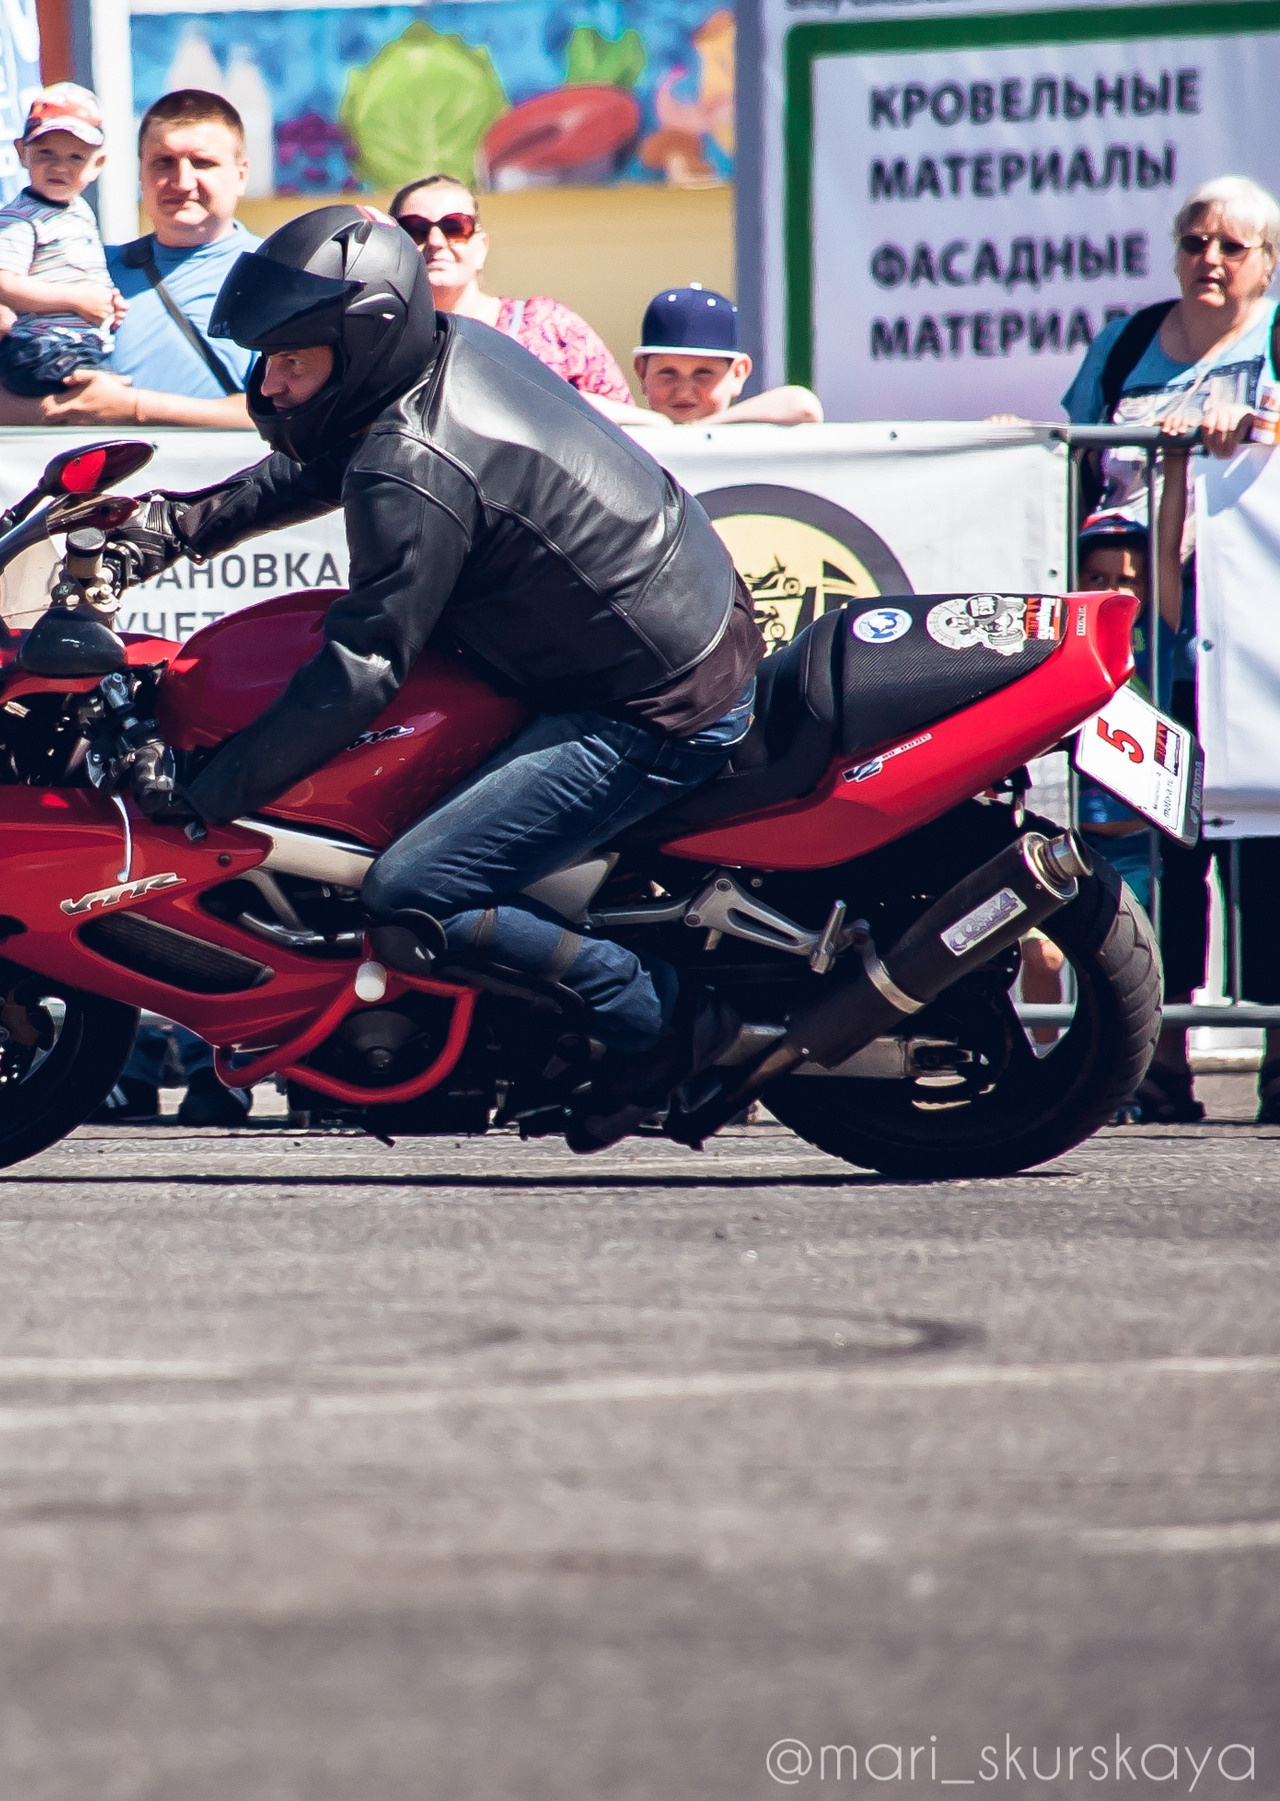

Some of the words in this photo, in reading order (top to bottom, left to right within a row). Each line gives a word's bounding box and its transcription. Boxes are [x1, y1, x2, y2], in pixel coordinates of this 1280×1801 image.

[869, 68, 1201, 128] КРОВЕЛЬНЫЕ
[869, 142, 1176, 200] МАТЕРИАЛЫ
[870, 232, 1150, 292] ФАСАДНЫЕ
[870, 306, 1128, 361] МАТЕРИА
[143, 552, 342, 589] АНОВКА
[1097, 716, 1144, 764] 5
